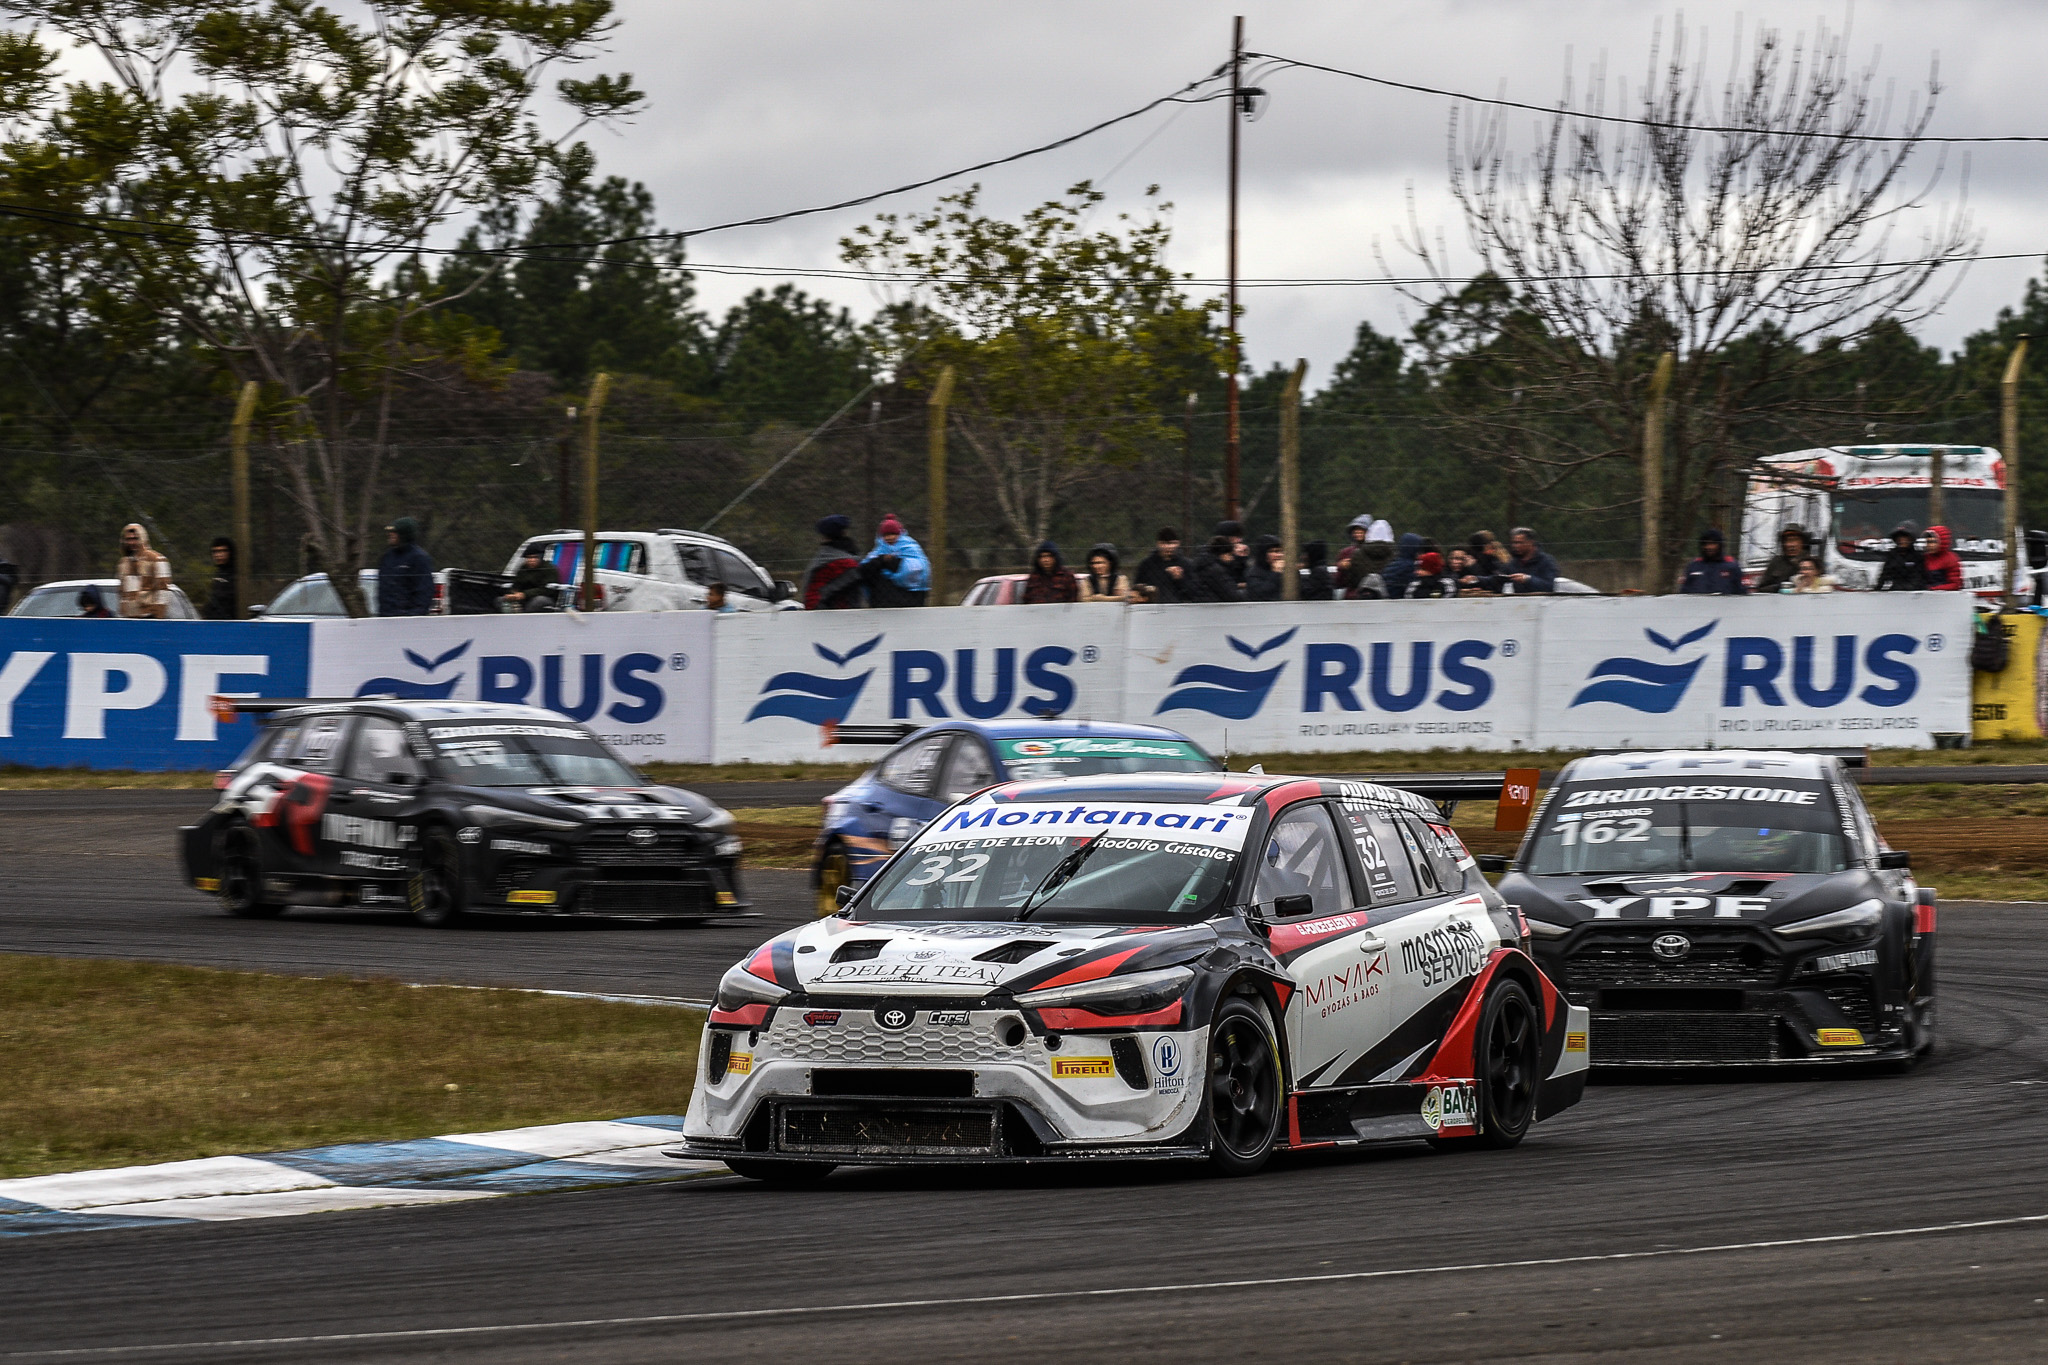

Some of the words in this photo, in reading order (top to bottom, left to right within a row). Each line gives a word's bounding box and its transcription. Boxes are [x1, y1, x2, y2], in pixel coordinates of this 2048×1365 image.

[1332, 723, 1410, 736] URUGUAY
[1415, 721, 1493, 734] SEGUROS
[1752, 718, 1834, 732] URUGUAY
[1838, 717, 1919, 731] SEGUROS
[600, 733, 666, 746] EGUROS
[1562, 785, 1821, 807] BRIDGESTONE
[1552, 818, 1653, 846] 162
[912, 838, 979, 856] PONCE
[981, 837, 1009, 849] DE
[1012, 836, 1067, 848] LEON
[1094, 837, 1159, 852] Rodolfo
[1165, 842, 1236, 863] Cristales
[1355, 835, 1387, 870] 32
[906, 854, 991, 887] 32
[1574, 897, 1772, 919] YPF
[831, 964, 922, 979] DELHI
[933, 964, 987, 980] TEA
[1422, 945, 1490, 988] SERVICE
[1305, 951, 1390, 1008] MIYAKI
[1321, 994, 1351, 1019] GYOZAS
[1361, 983, 1380, 1001] BAOS
[1056, 1060, 1110, 1075] PIRELLI
[1154, 1076, 1185, 1089] Hilton
